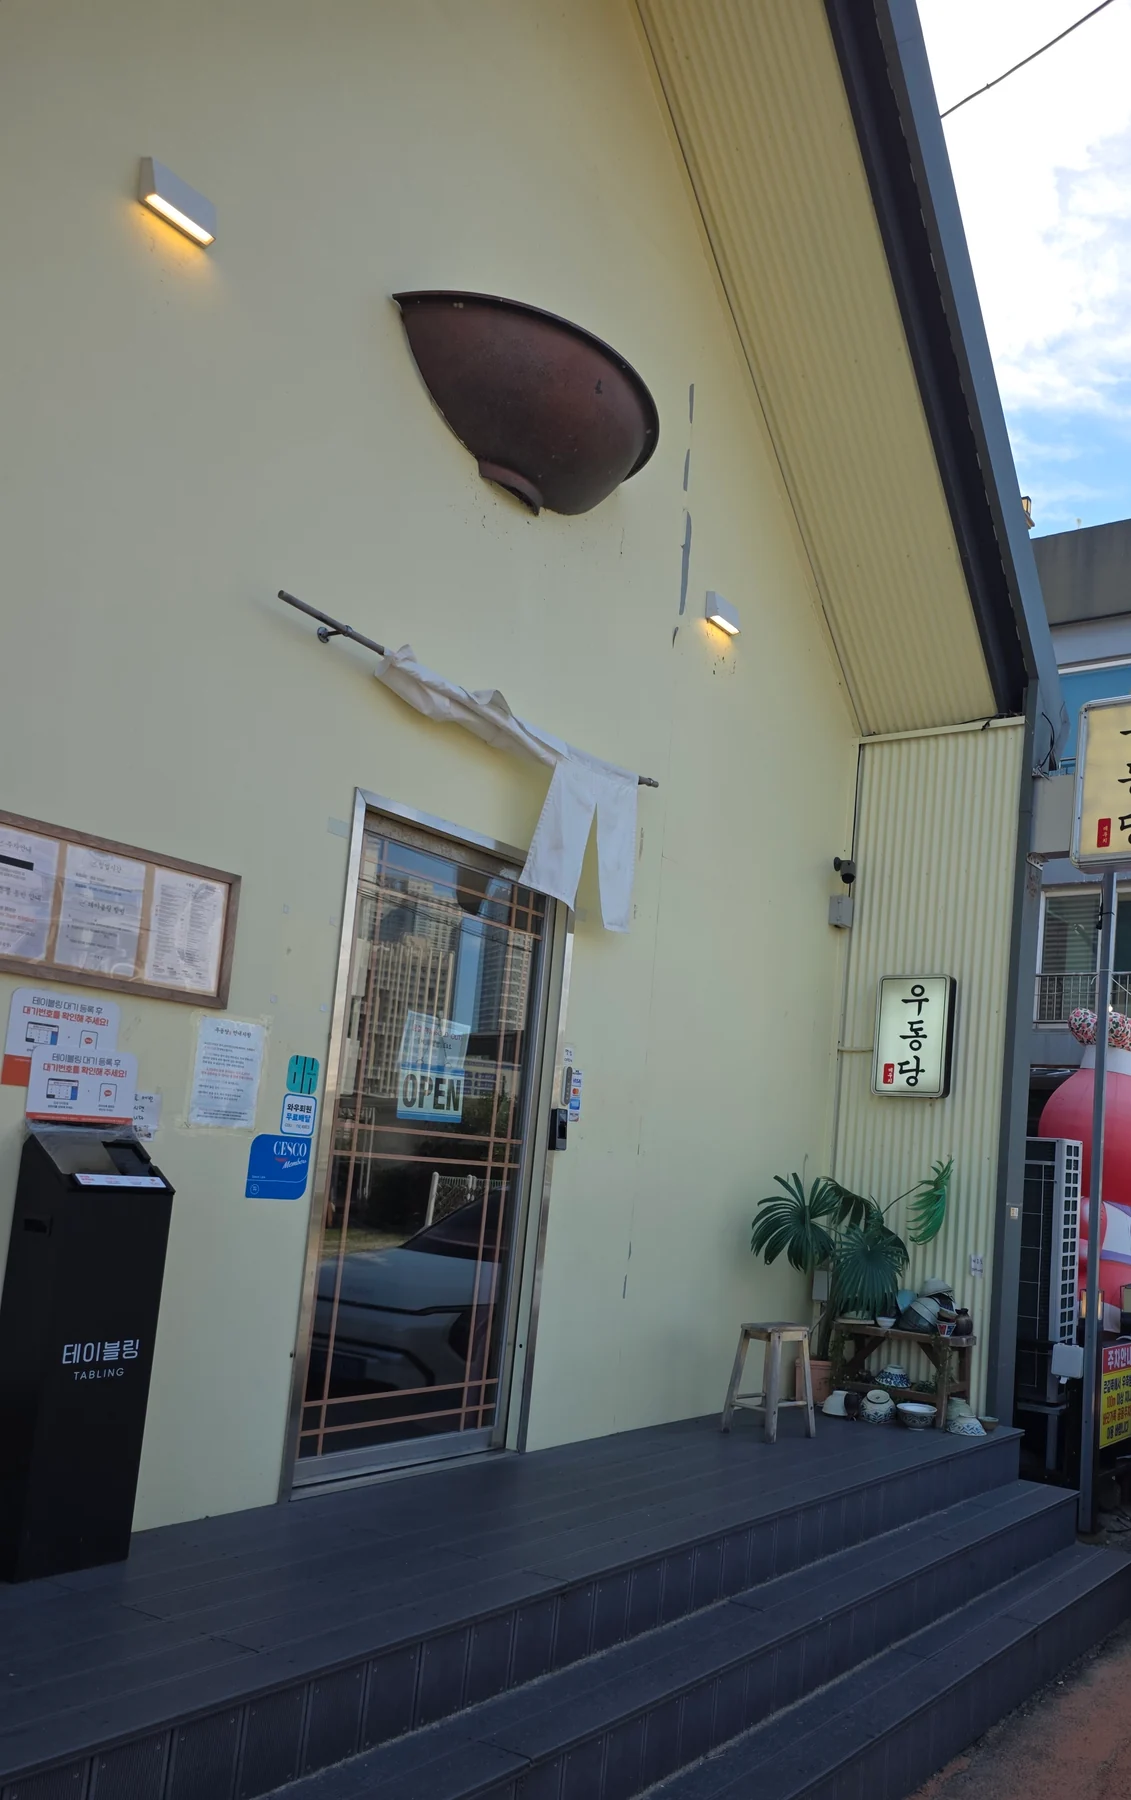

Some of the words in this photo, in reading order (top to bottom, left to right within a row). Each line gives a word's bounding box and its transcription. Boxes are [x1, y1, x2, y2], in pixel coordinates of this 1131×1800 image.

[32, 996, 63, 1010] 테이블링
[63, 1002, 79, 1011] 대기
[80, 1004, 95, 1014] 등록
[95, 1006, 104, 1016] 후
[22, 1005, 60, 1020] 대기번호를
[61, 1011, 84, 1022] 확인해
[85, 1016, 109, 1027] 주세요!
[897, 984, 930, 1087] 우동당
[52, 1052, 82, 1064] 테이블링
[82, 1056, 98, 1066] 대기
[98, 1058, 113, 1067] 등록
[114, 1059, 121, 1067] 후
[42, 1062, 80, 1074] 대기번호를
[81, 1065, 103, 1077] 확인해
[103, 1068, 128, 1078] 주세요!
[402, 1073, 461, 1111] OPEN
[286, 1103, 312, 1114] 와우회원
[285, 1112, 311, 1123] 무료배달
[273, 1140, 307, 1157] CESCO
[62, 1339, 140, 1364] 테이블링
[73, 1367, 125, 1381] TABLING
